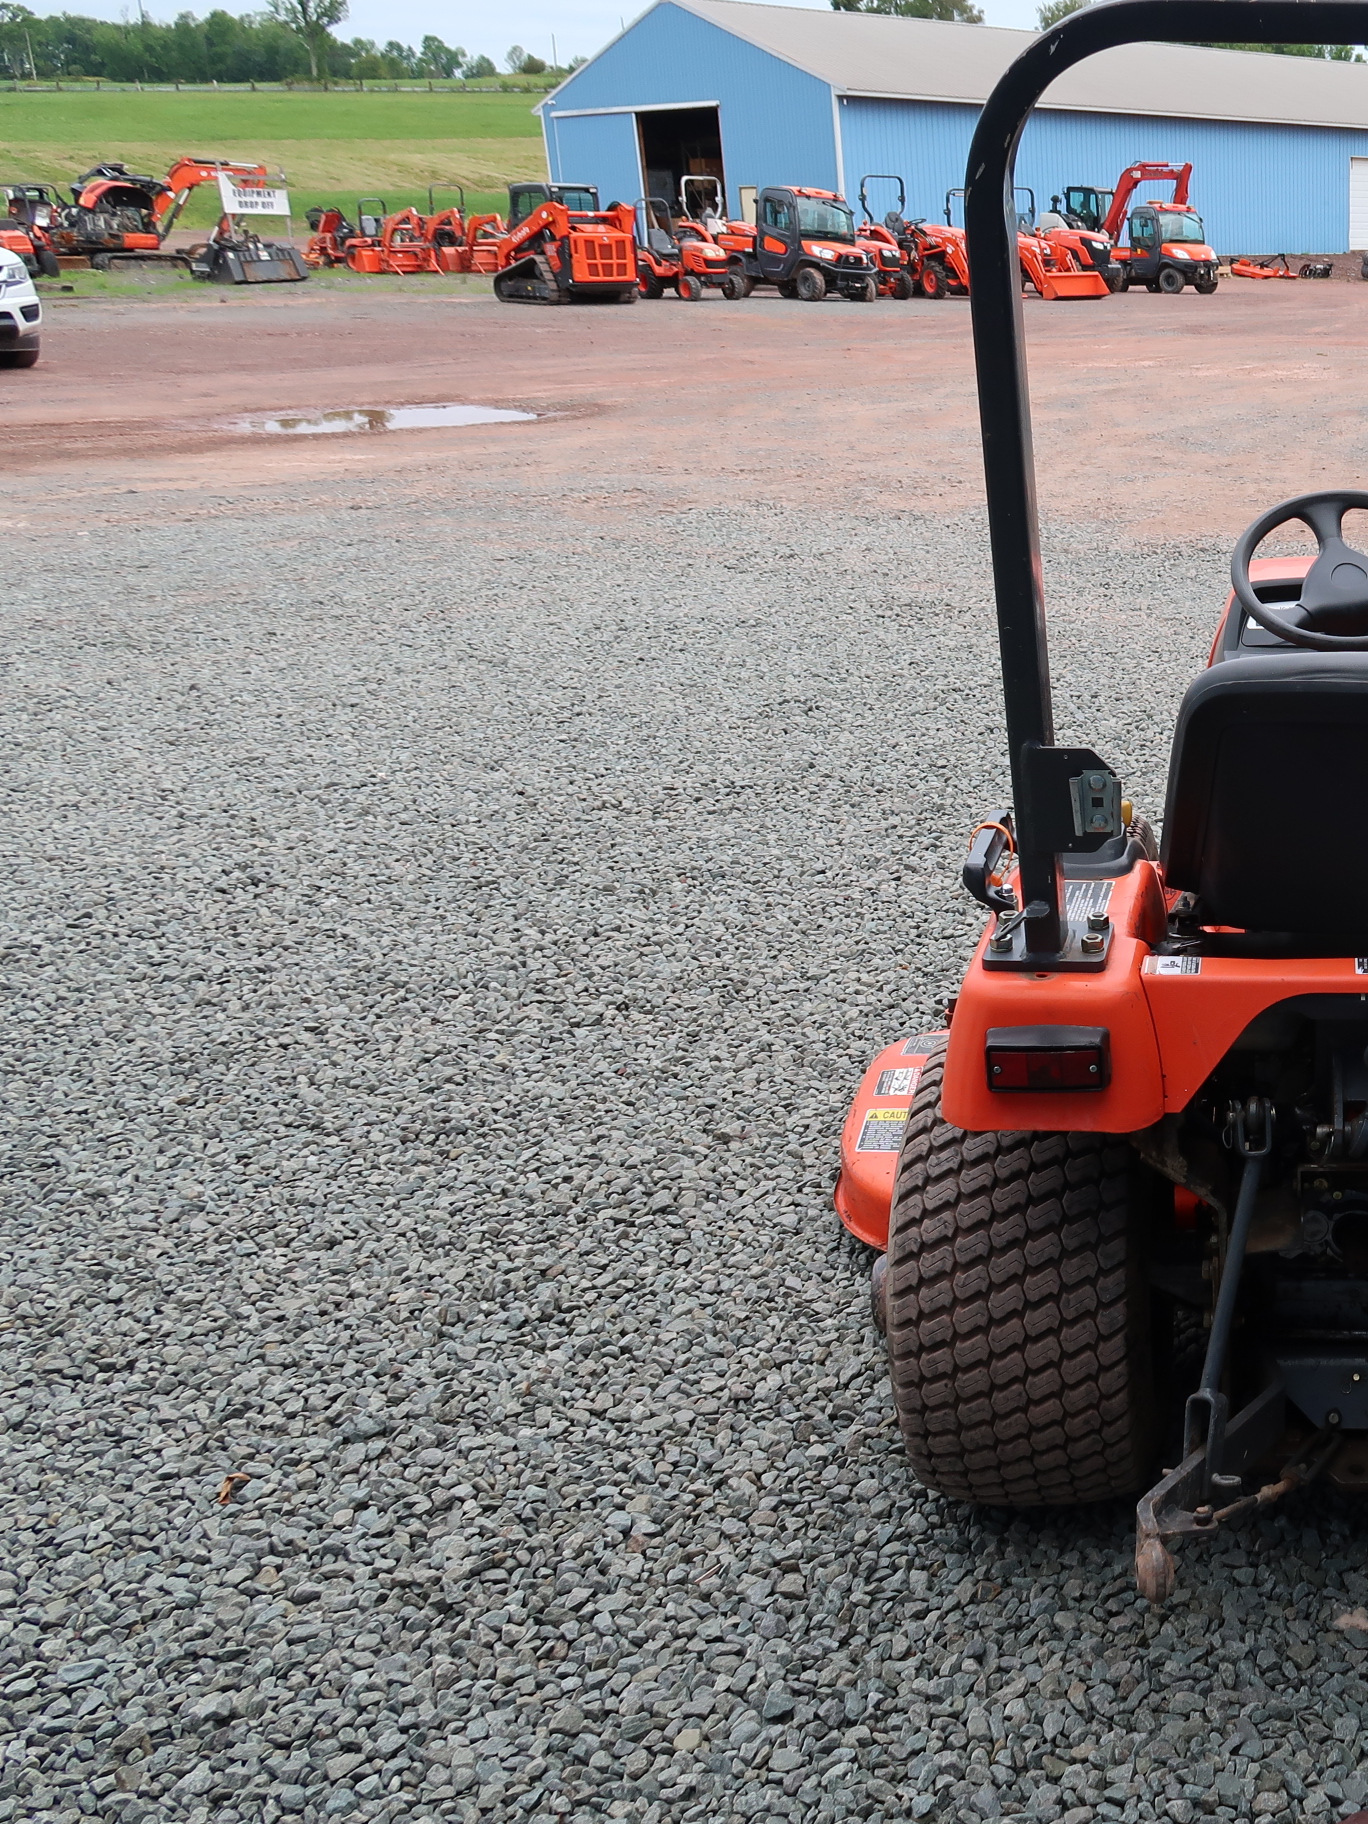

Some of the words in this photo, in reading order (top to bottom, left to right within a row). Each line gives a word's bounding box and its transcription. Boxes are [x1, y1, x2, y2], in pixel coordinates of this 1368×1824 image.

[232, 189, 276, 199] EQUIPMENT
[238, 201, 259, 209] DROP
[261, 201, 275, 210] OFF
[883, 1111, 909, 1119] CAUT
